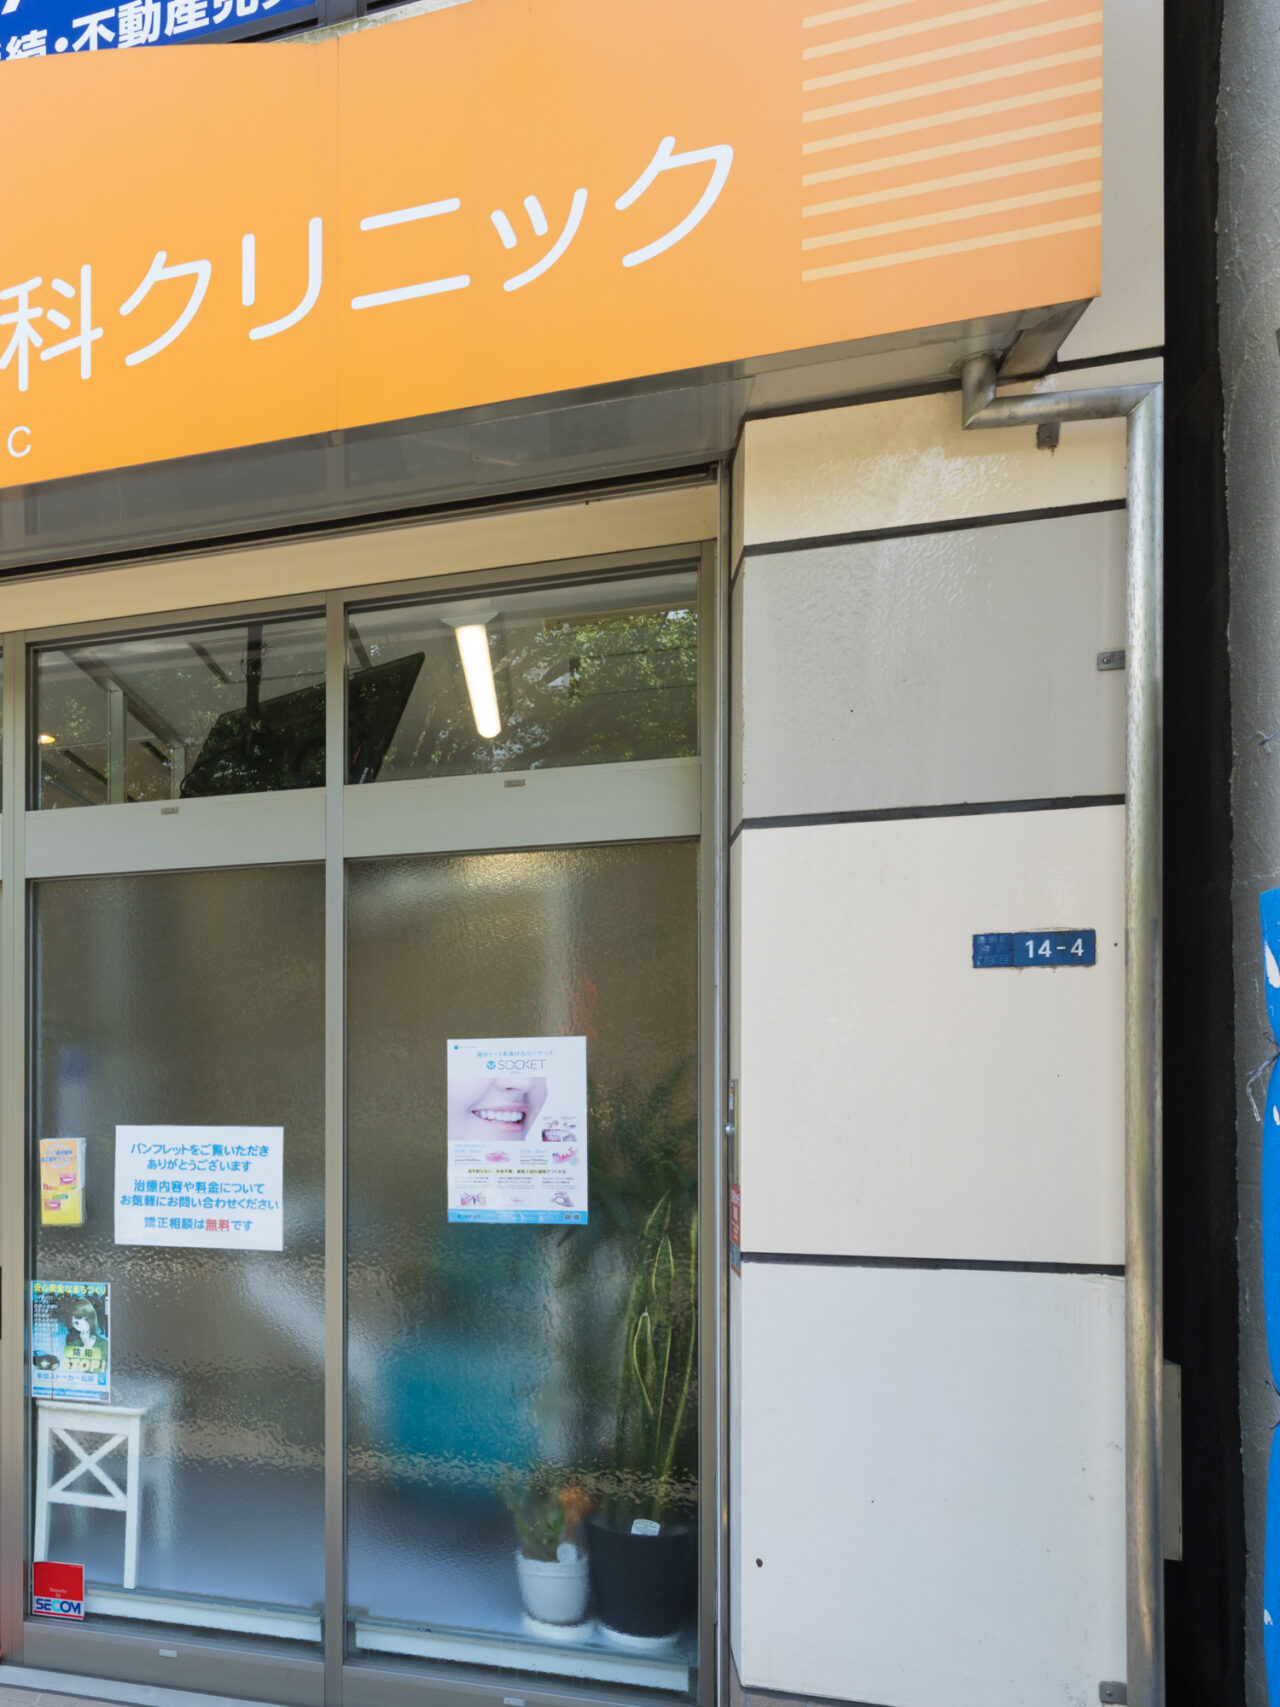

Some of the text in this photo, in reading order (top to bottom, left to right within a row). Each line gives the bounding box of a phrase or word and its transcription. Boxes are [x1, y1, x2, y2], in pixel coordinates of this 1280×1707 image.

[1025, 938, 1085, 958] 14-4
[497, 1059, 546, 1071] SOCKET
[130, 1142, 270, 1158] パンフレットをご覧いただき
[147, 1158, 252, 1173] ありがとうございます
[133, 1179, 265, 1195] 治療内容や料金について
[120, 1194, 280, 1211] お気軽にお問い合わせください
[35, 1598, 82, 1615] SECOM
